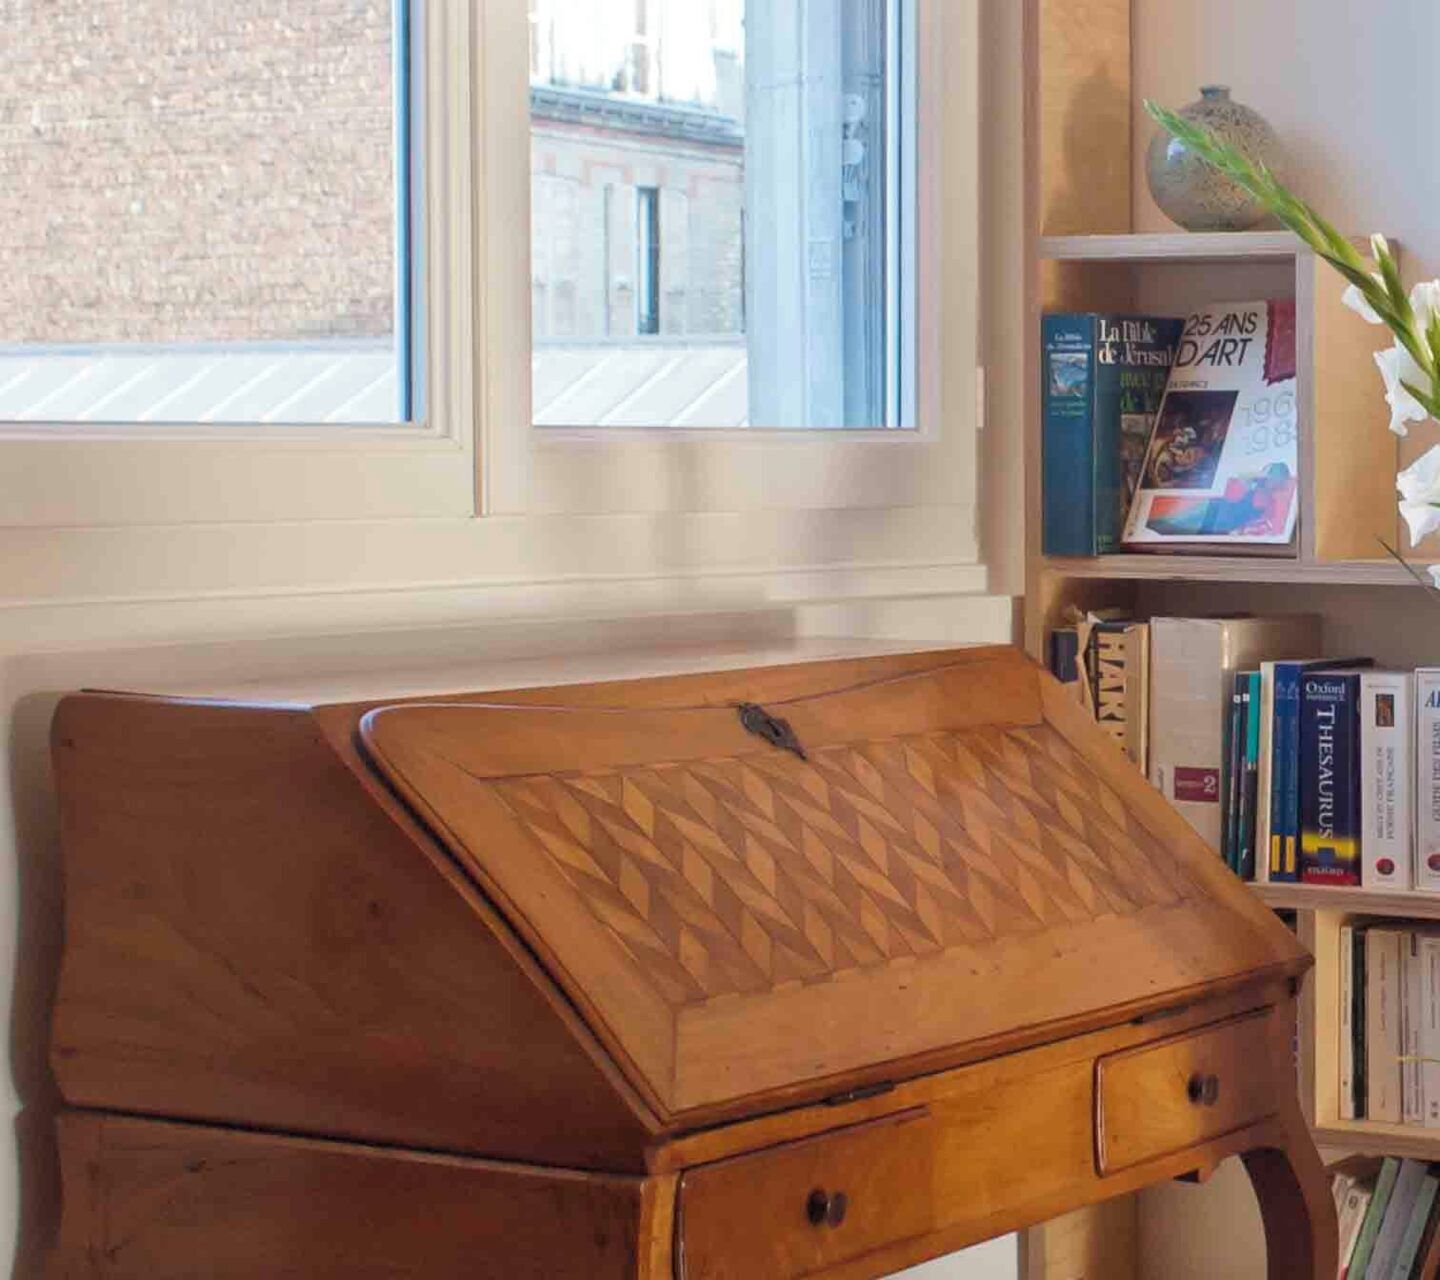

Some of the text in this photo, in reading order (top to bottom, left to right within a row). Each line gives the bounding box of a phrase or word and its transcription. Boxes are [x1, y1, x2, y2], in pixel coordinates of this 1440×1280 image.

[1100, 320, 1121, 342] La
[1187, 312, 1258, 333] 25 ANS
[1099, 347, 1118, 365] de
[1305, 681, 1346, 694] Oxford
[1316, 705, 1336, 838] THESAURUS
[1432, 759, 1440, 780] DES
[1203, 776, 1217, 794] 2
